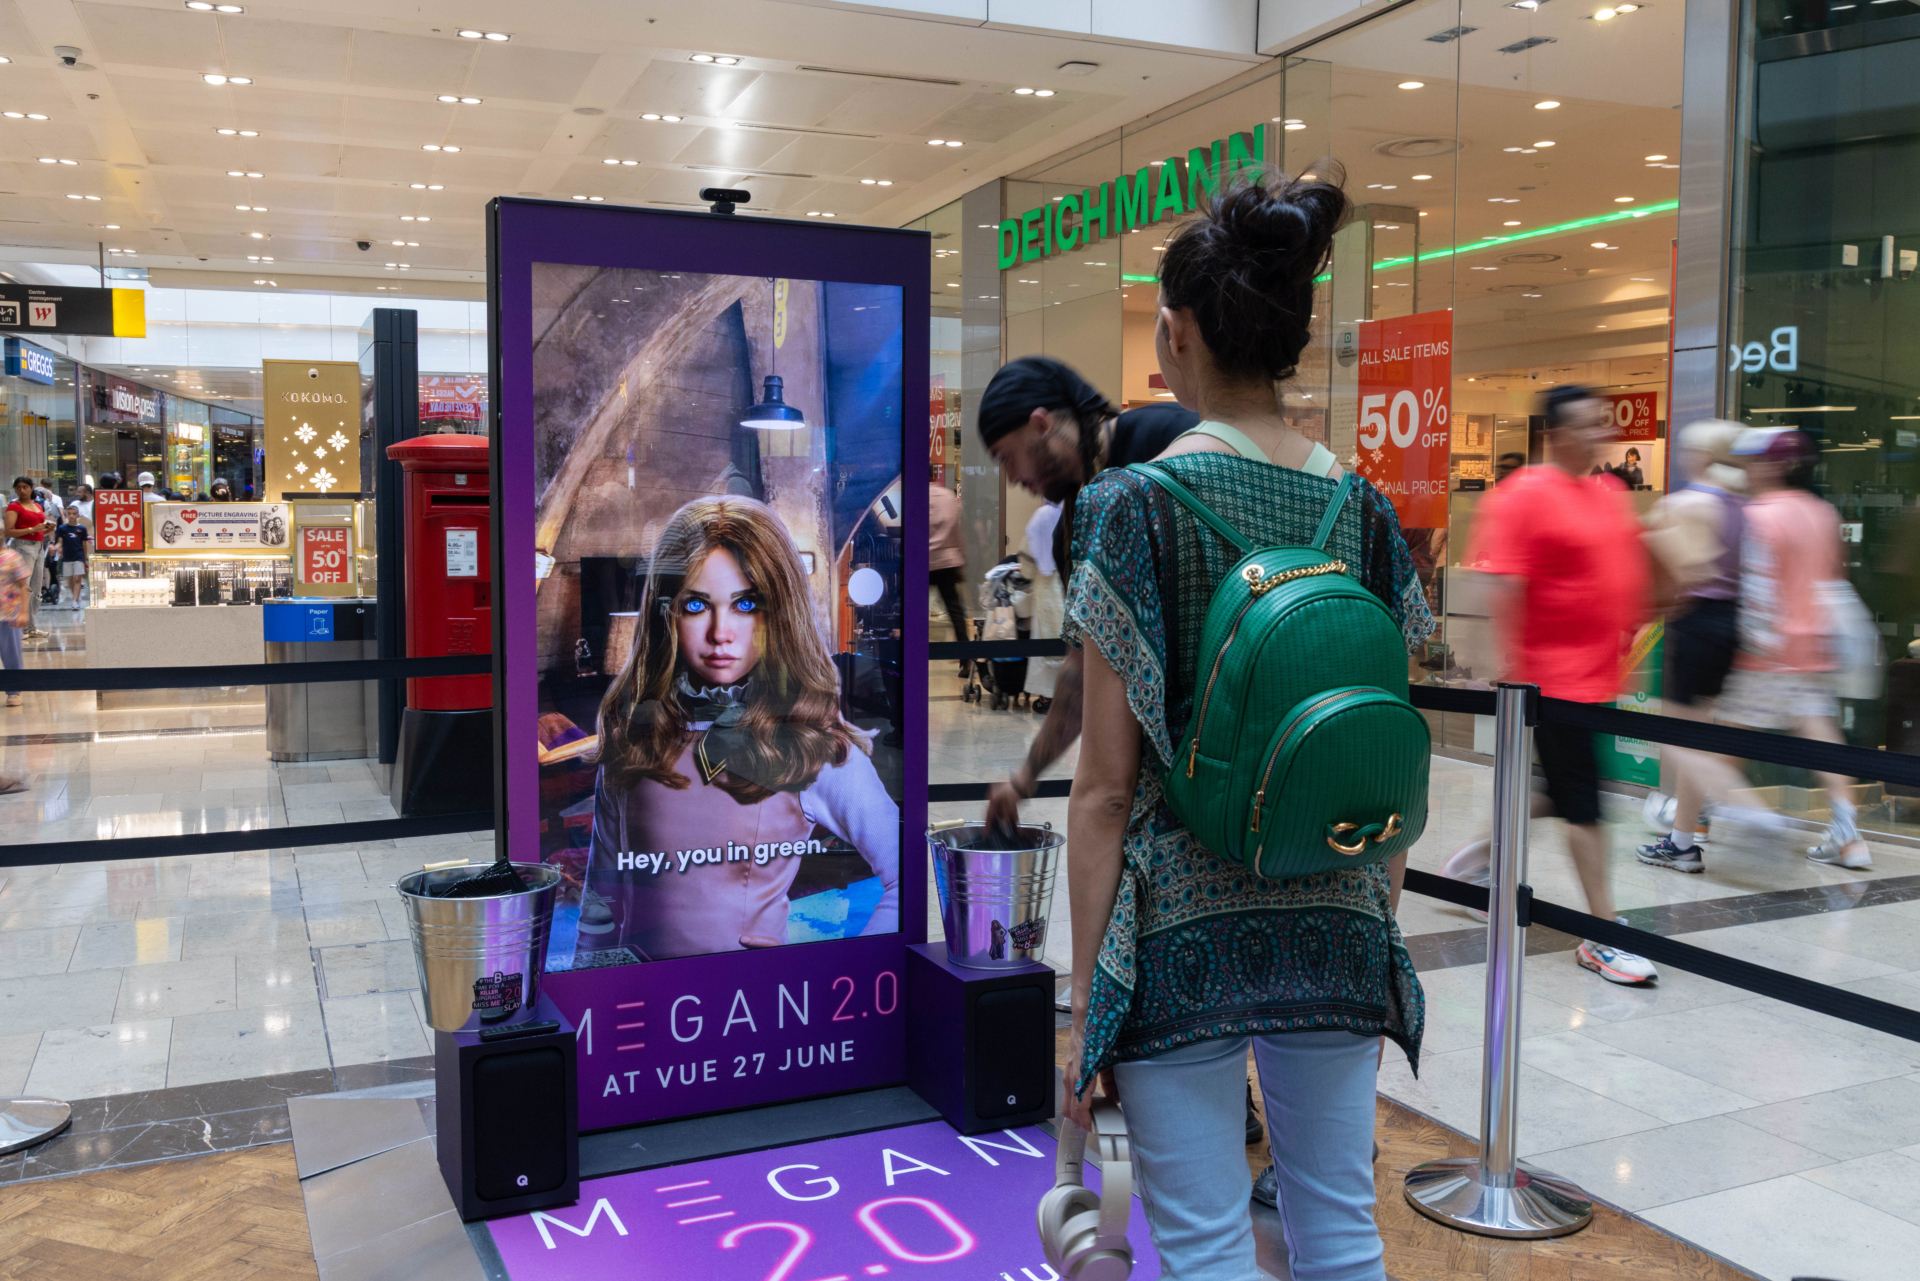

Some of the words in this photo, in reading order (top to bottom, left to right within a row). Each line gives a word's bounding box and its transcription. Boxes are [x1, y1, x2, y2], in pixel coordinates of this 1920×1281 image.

[998, 123, 1264, 271] DEICHMANN
[1361, 351, 1381, 366] ALL
[1382, 346, 1411, 363] SALE
[1414, 341, 1449, 358] ITEMS
[27, 350, 53, 378] GREGGS
[1629, 428, 1649, 436] PRICE
[1422, 432, 1448, 448] OFF
[932, 464, 942, 479] FF
[1370, 480, 1410, 495] GINAL
[1412, 480, 1446, 494] PRICE
[99, 492, 138, 505] SALE
[104, 511, 140, 532] 50%
[104, 535, 135, 547] OFF
[307, 530, 344, 542] SALE
[312, 548, 346, 568] 50%
[312, 572, 340, 583] OFF
[1638, 692, 1645, 700] D
[617, 851, 672, 874] Hey,
[676, 847, 720, 872] you
[727, 840, 748, 862] in
[754, 838, 828, 866] green.
[494, 972, 502, 984] B
[505, 986, 521, 1000] 2.0
[832, 971, 898, 1022] 2.0
[504, 1002, 521, 1012] SLAY
[602, 1071, 640, 1097] AT
[656, 1060, 717, 1088] VUE
[733, 1053, 766, 1078] 27
[778, 1040, 854, 1071] JUNE
[1007, 1095, 1016, 1105] Q
[516, 1174, 528, 1186] Q
[718, 1196, 975, 1281] 2.0
